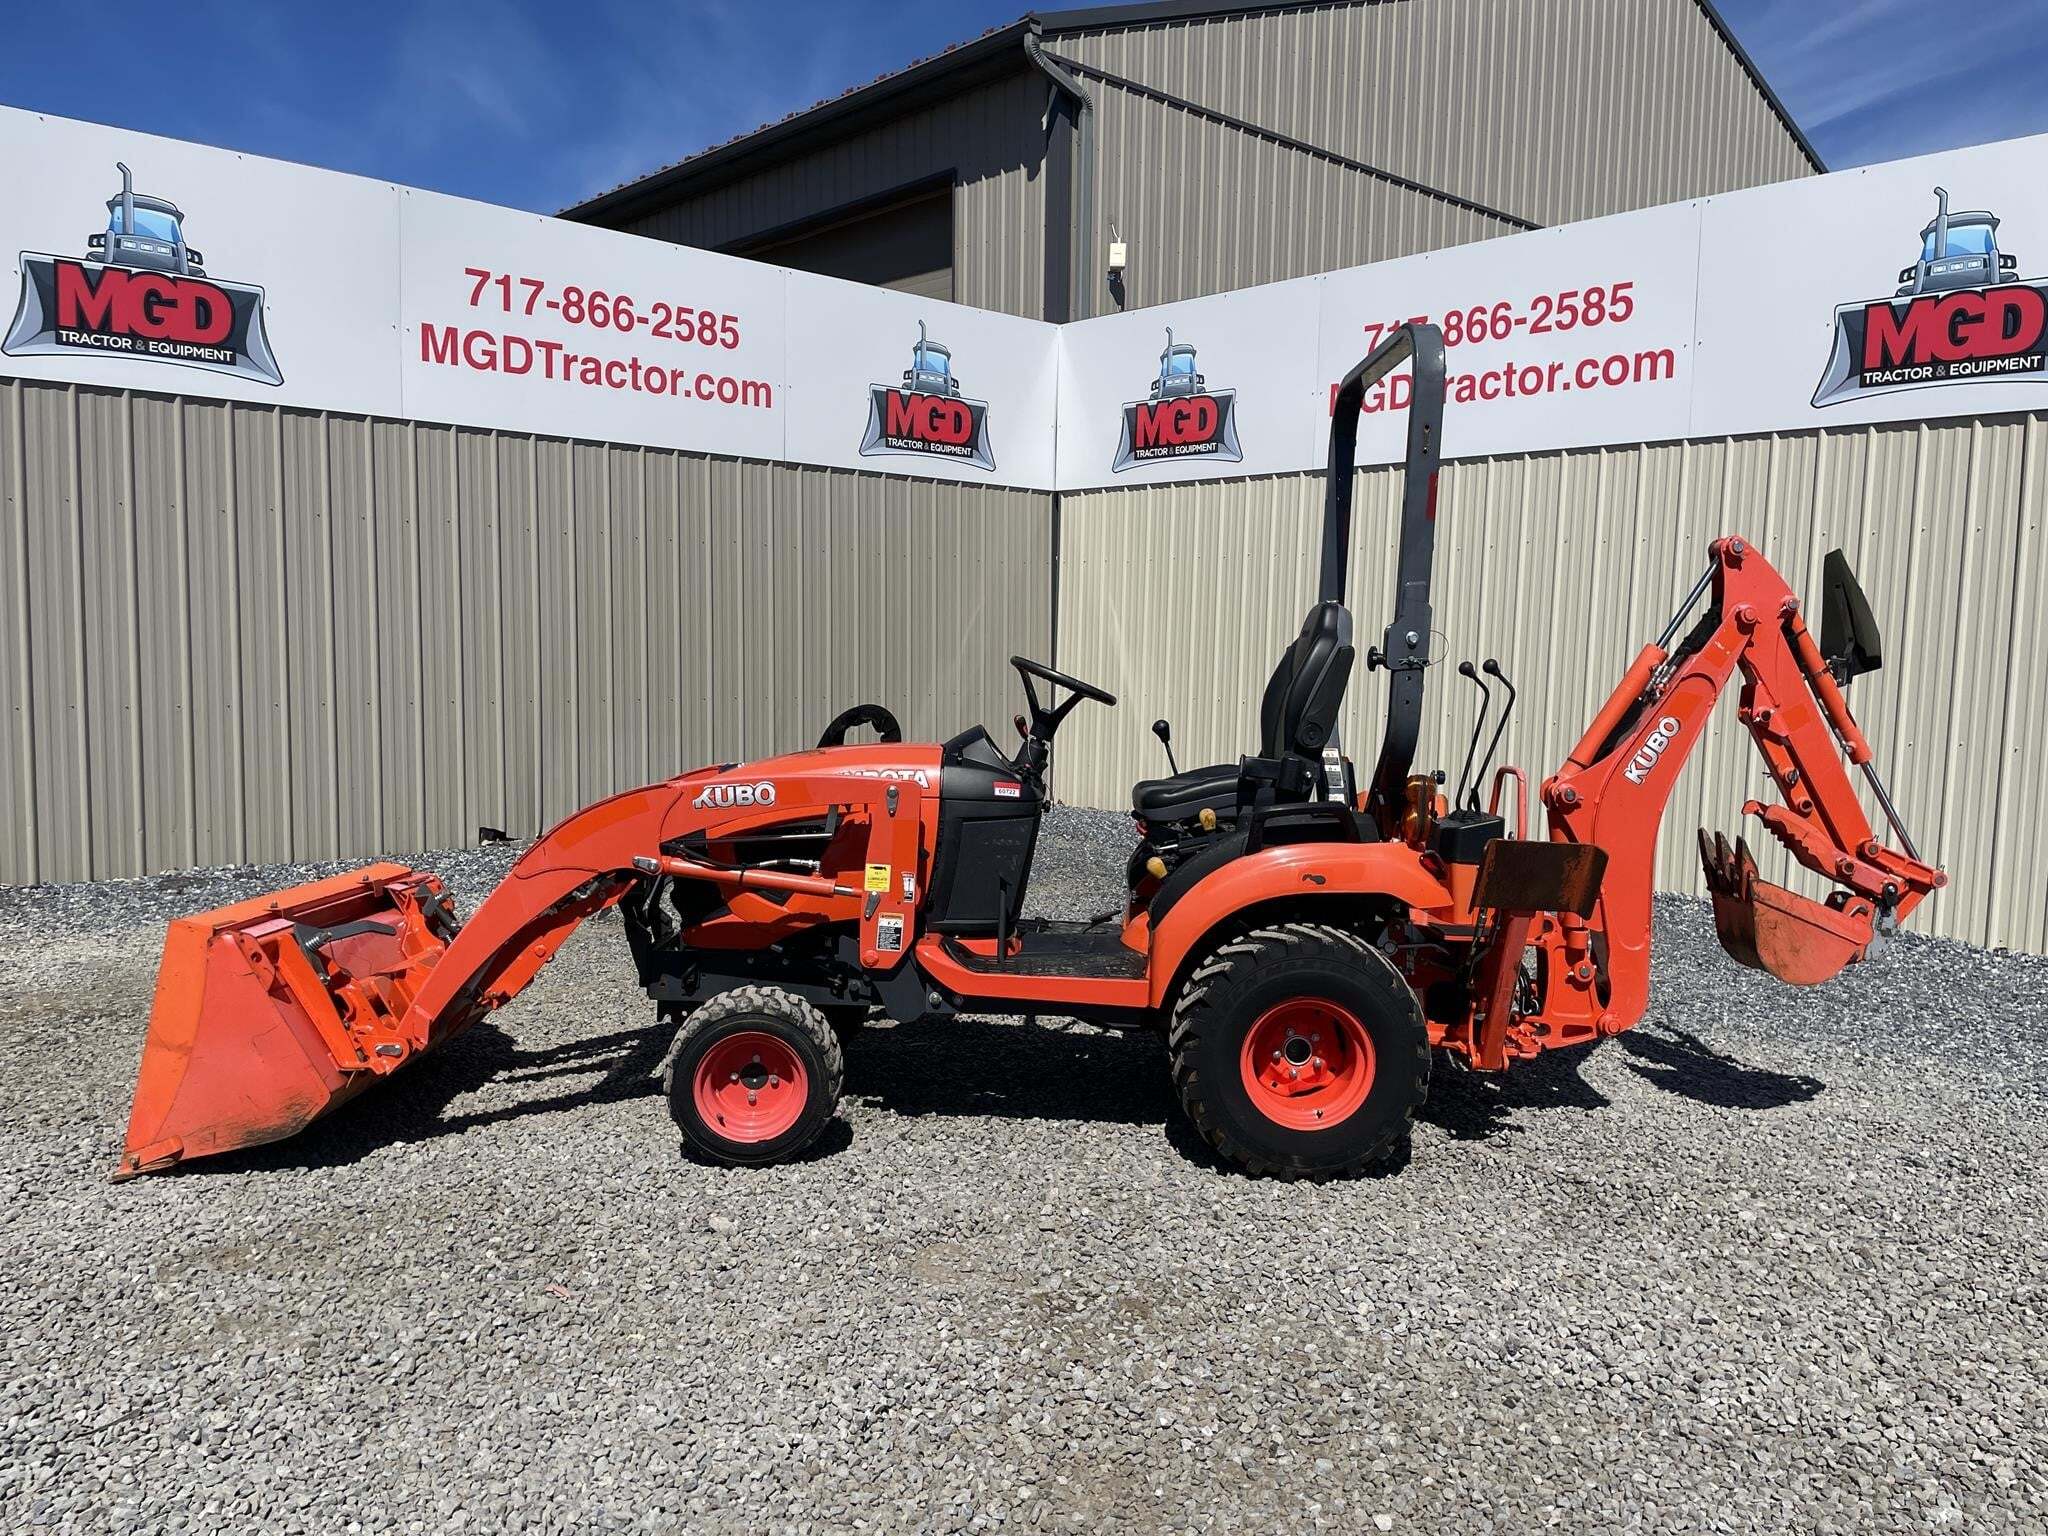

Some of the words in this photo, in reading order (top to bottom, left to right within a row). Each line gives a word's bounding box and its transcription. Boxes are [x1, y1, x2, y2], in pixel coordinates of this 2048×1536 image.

[56, 261, 234, 345] MGD
[464, 267, 740, 350] 717-866-2585
[1864, 287, 2045, 370] MGD
[59, 330, 133, 350] TRACTOR
[135, 339, 147, 351] &
[149, 341, 233, 362] EQUIPMENT
[420, 322, 772, 408] MGDTractor.com
[1864, 366, 1933, 384] TRACTOR
[1935, 365, 1946, 377] &
[1950, 355, 2042, 376] EQUIPMENT
[887, 390, 972, 444] MGD
[1136, 396, 1218, 447] MGD
[887, 437, 923, 450] TRACTOR
[930, 443, 972, 456] EQUIPMENT
[1136, 447, 1168, 458] TRACTOR
[1175, 442, 1217, 455] EQUIPMENT
[1623, 716, 1681, 785] KUBO
[693, 781, 776, 809] KUBO
